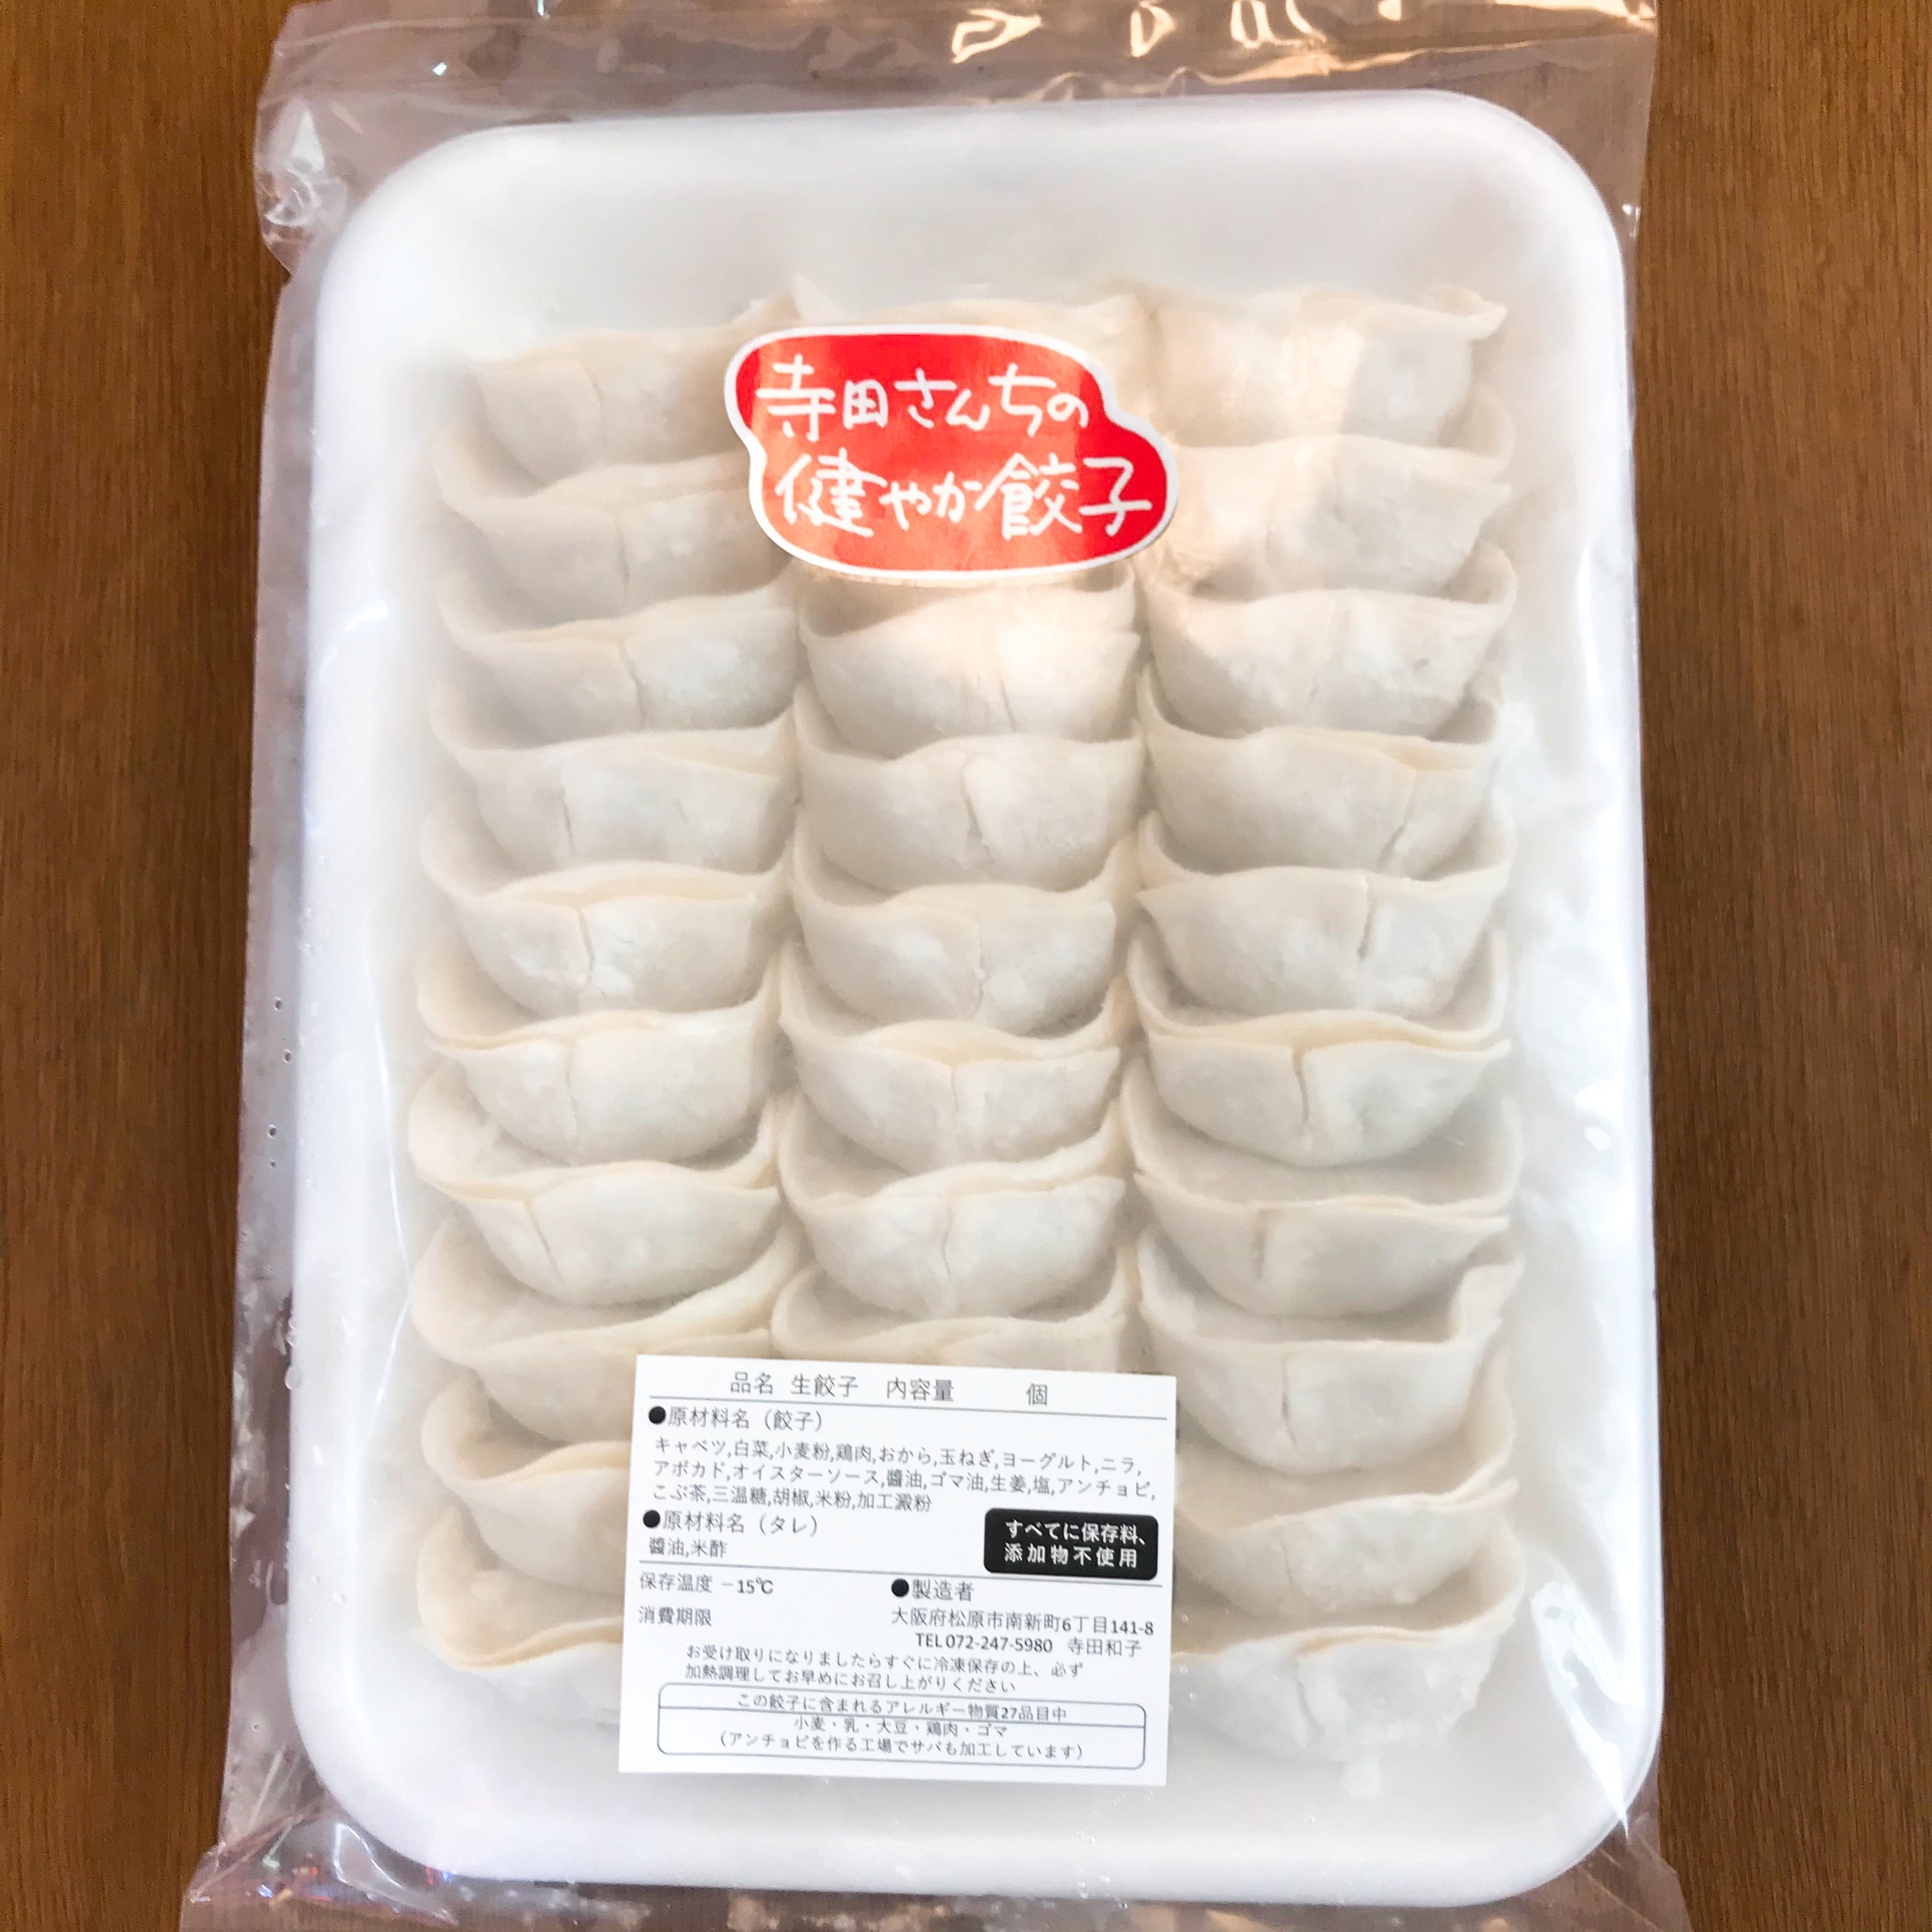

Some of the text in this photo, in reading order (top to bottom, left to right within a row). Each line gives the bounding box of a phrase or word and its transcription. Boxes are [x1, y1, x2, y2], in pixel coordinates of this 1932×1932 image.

[755, 352, 1089, 443] 寺田さんちの
[774, 446, 1153, 540] 健やか餃子
[730, 1371, 1048, 1406] 品名 生餃子 内容量 個
[1004, 1519, 1146, 1545] すべてに保存料、
[1004, 1542, 1138, 1568] 添加物不使用
[640, 1572, 713, 1593] 保存温度
[912, 1579, 974, 1602] 製造者
[638, 1605, 713, 1627] 消費期限
[891, 1606, 1154, 1636] 大阪府松原市南新町6丁目141-8
[916, 1632, 1142, 1659] TEL 072-247-5980 寺田和子
